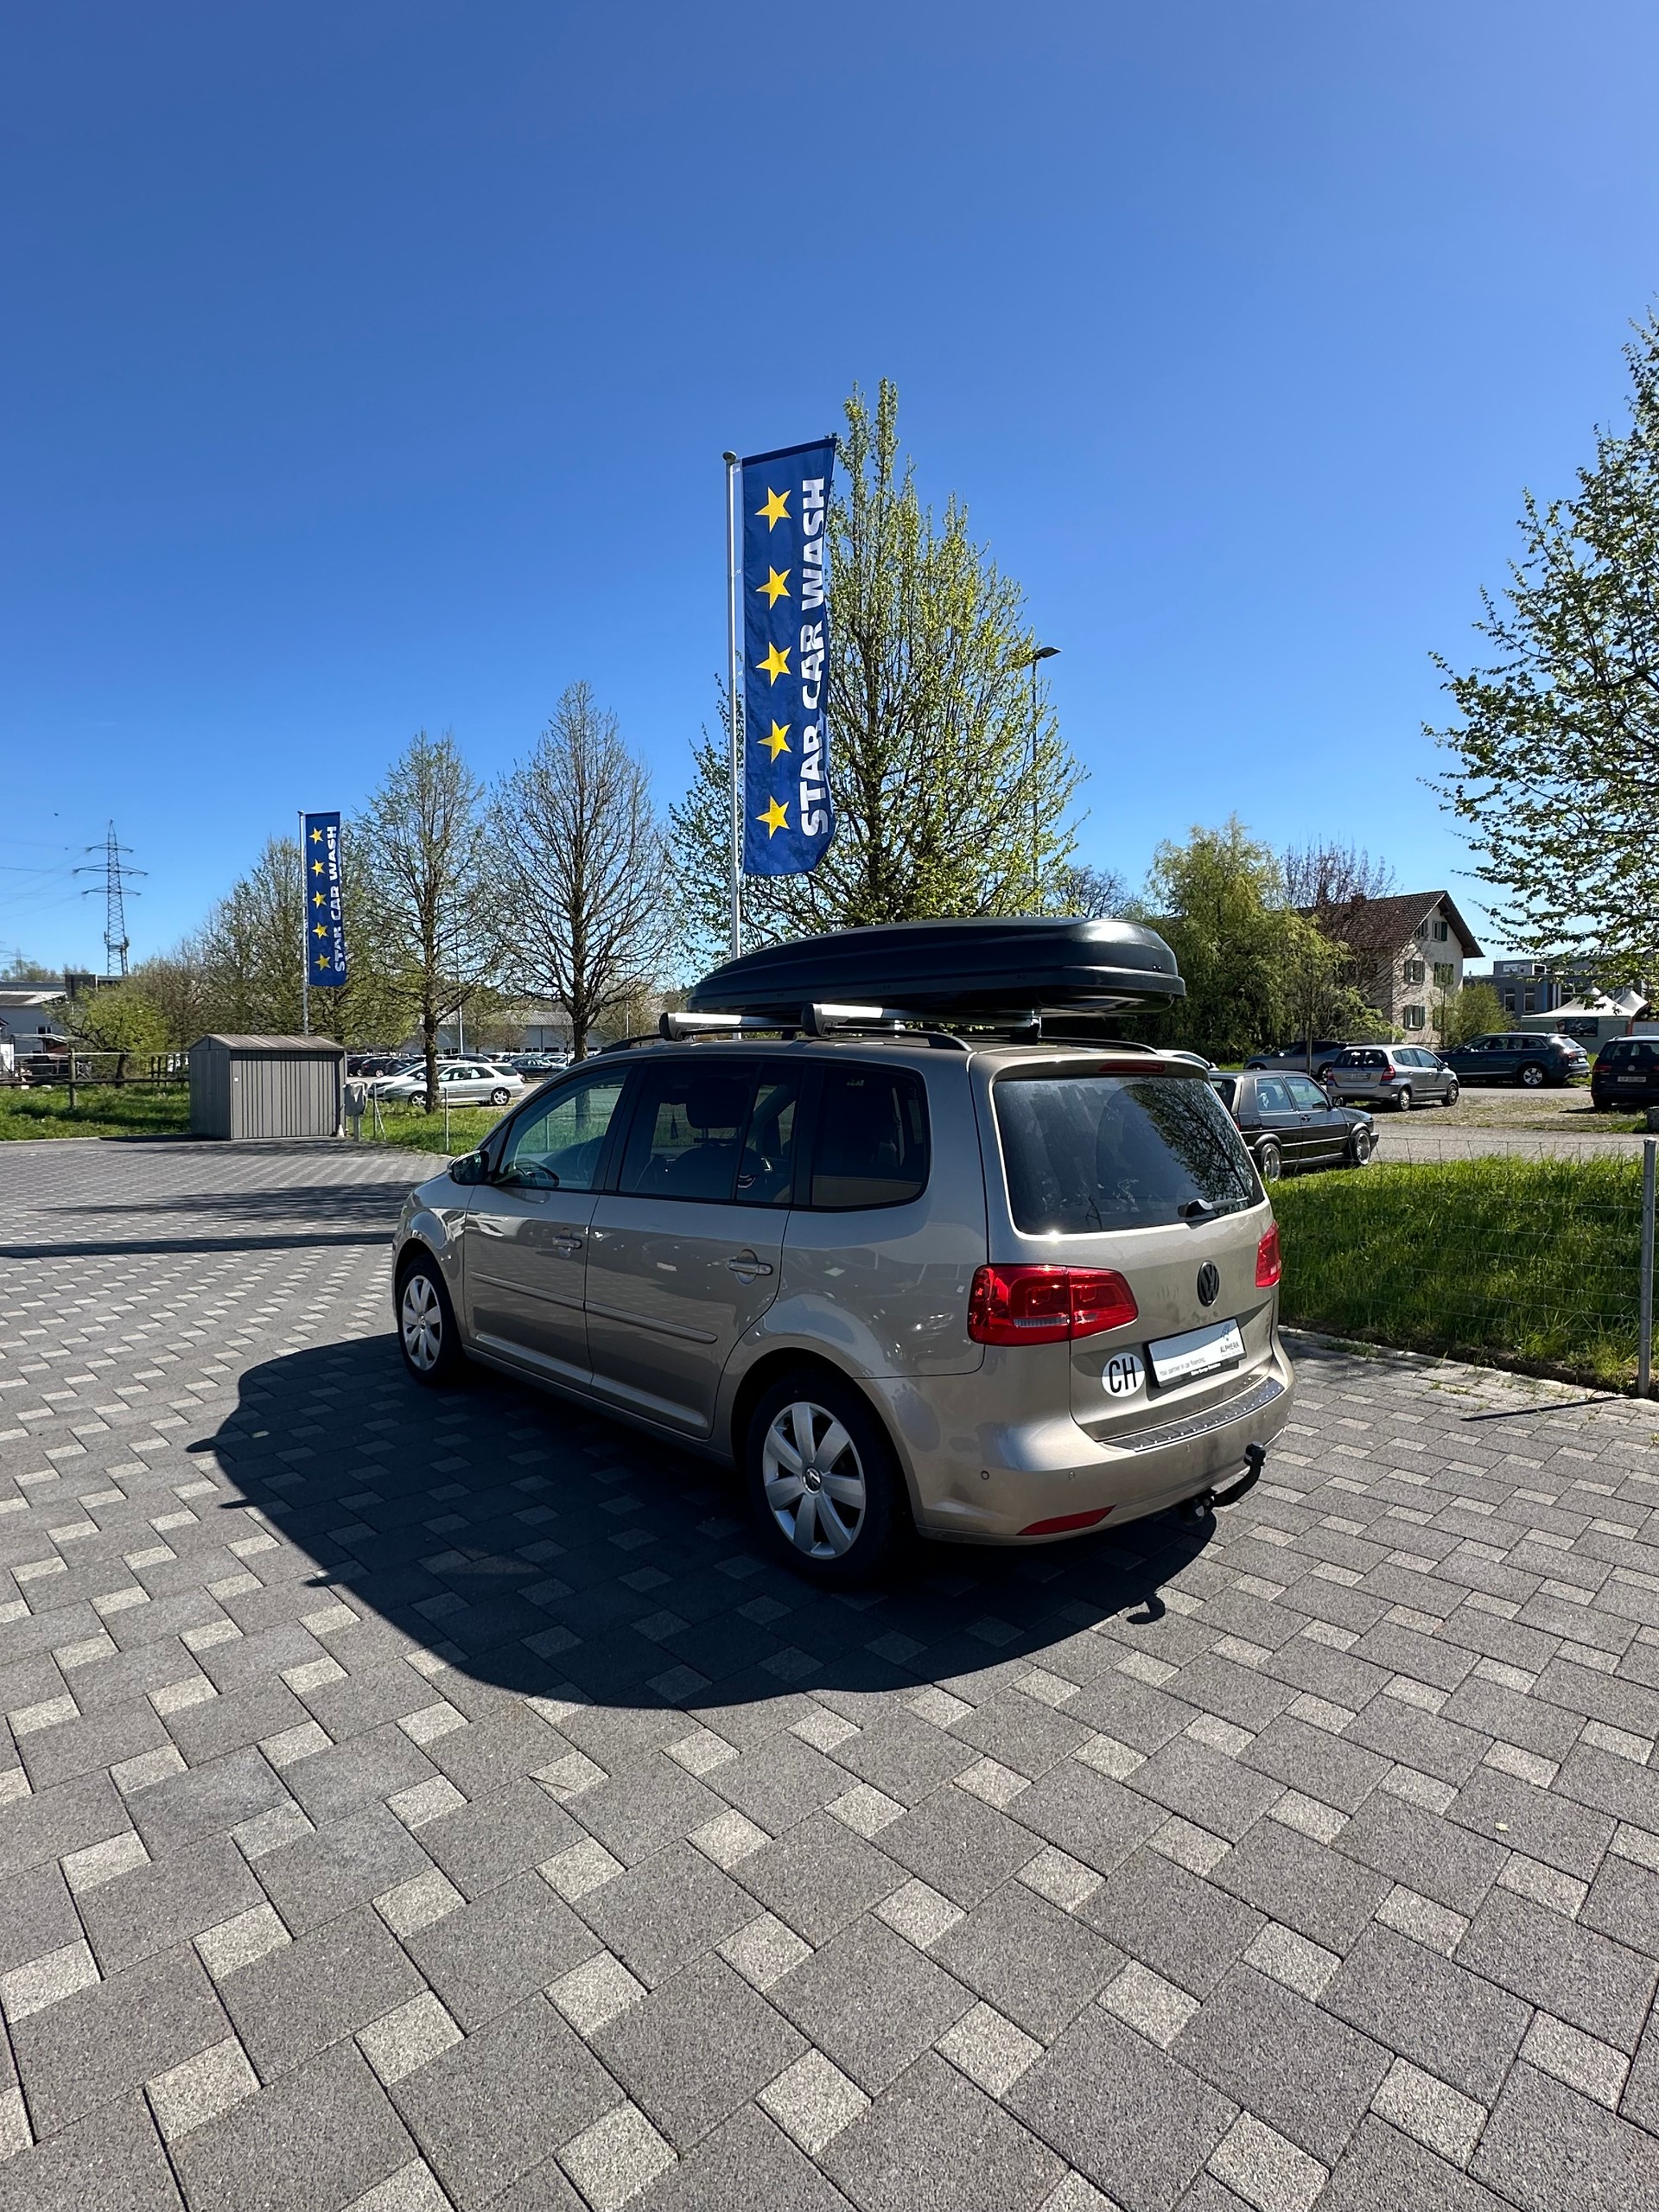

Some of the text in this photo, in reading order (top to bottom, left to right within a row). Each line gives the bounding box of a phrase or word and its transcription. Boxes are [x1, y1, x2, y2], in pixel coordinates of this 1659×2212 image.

[799, 476, 829, 836] STAR CAR WASH
[327, 825, 346, 972] STAR CAR WASH
[1109, 1357, 1137, 1394] CH
